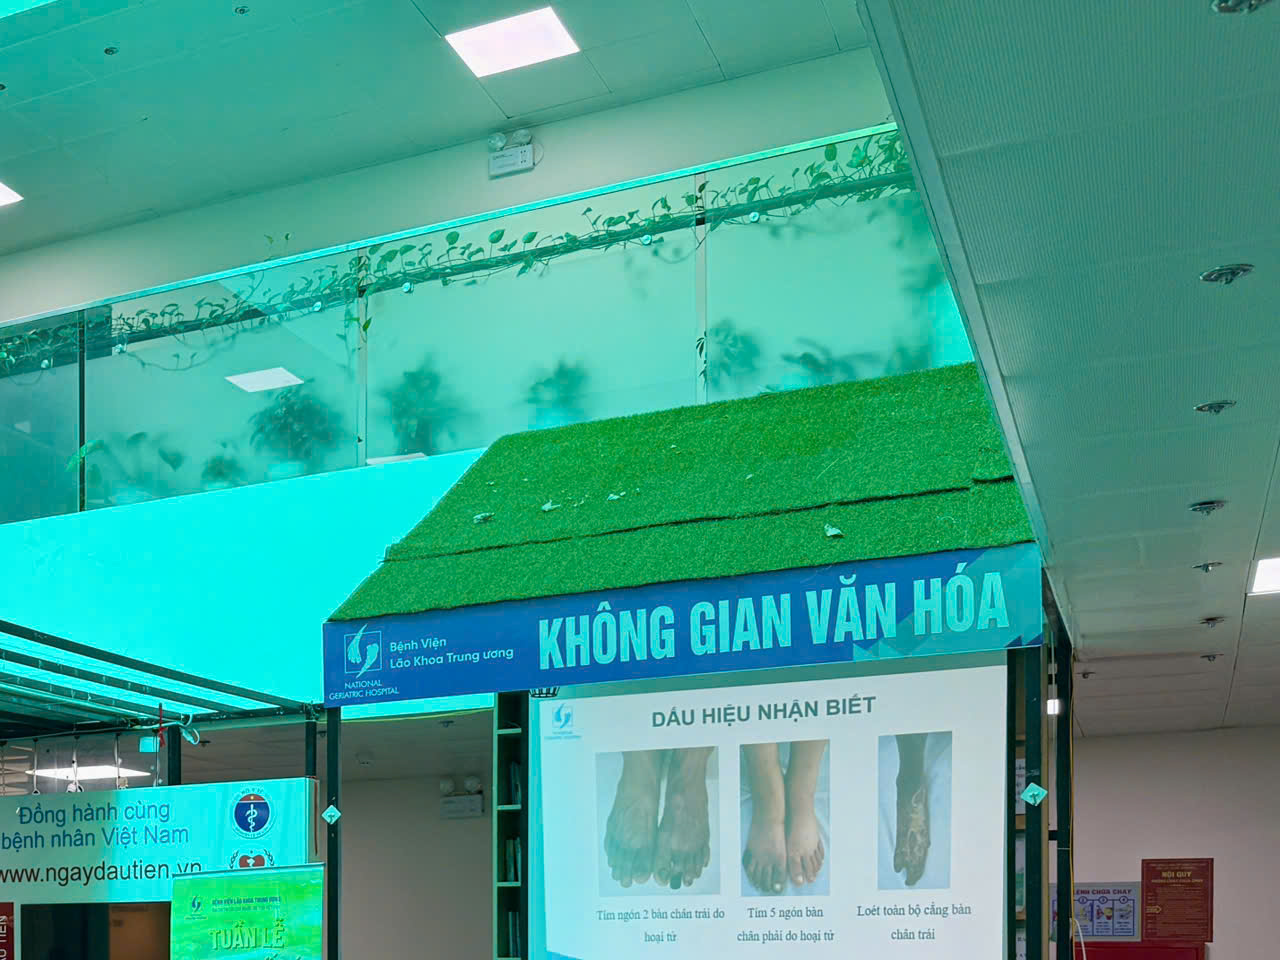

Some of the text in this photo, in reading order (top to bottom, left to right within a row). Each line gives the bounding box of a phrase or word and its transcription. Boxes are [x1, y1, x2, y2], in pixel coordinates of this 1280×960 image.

[537, 561, 1011, 671] KHÔNG GIAN VĂN HÓA
[389, 637, 447, 654] Bệnh Viện
[390, 648, 515, 669] Lão Khoa Trung ương
[344, 679, 383, 689] NATIONAL
[328, 687, 400, 701] GERIATRIC HOSPITAL
[651, 693, 877, 727] DẤU HIỆU NHẬN BIẾT
[19, 801, 170, 828] Đồng hành cùng
[1, 826, 189, 852] bệnh nhân Việt Nam
[596, 908, 726, 923] Tím ngón 2 bàn chân trái do
[746, 906, 824, 921] Tím 5 ngón bàn
[856, 901, 972, 918] Loét toàn bộ cẳng bàn
[208, 918, 288, 951] TUẦN LỄ
[644, 931, 664, 944] hoại
[736, 930, 760, 942] chân
[762, 929, 783, 945] phải
[785, 930, 798, 941] do
[800, 929, 821, 943] hoại
[890, 928, 936, 941] chân trái
